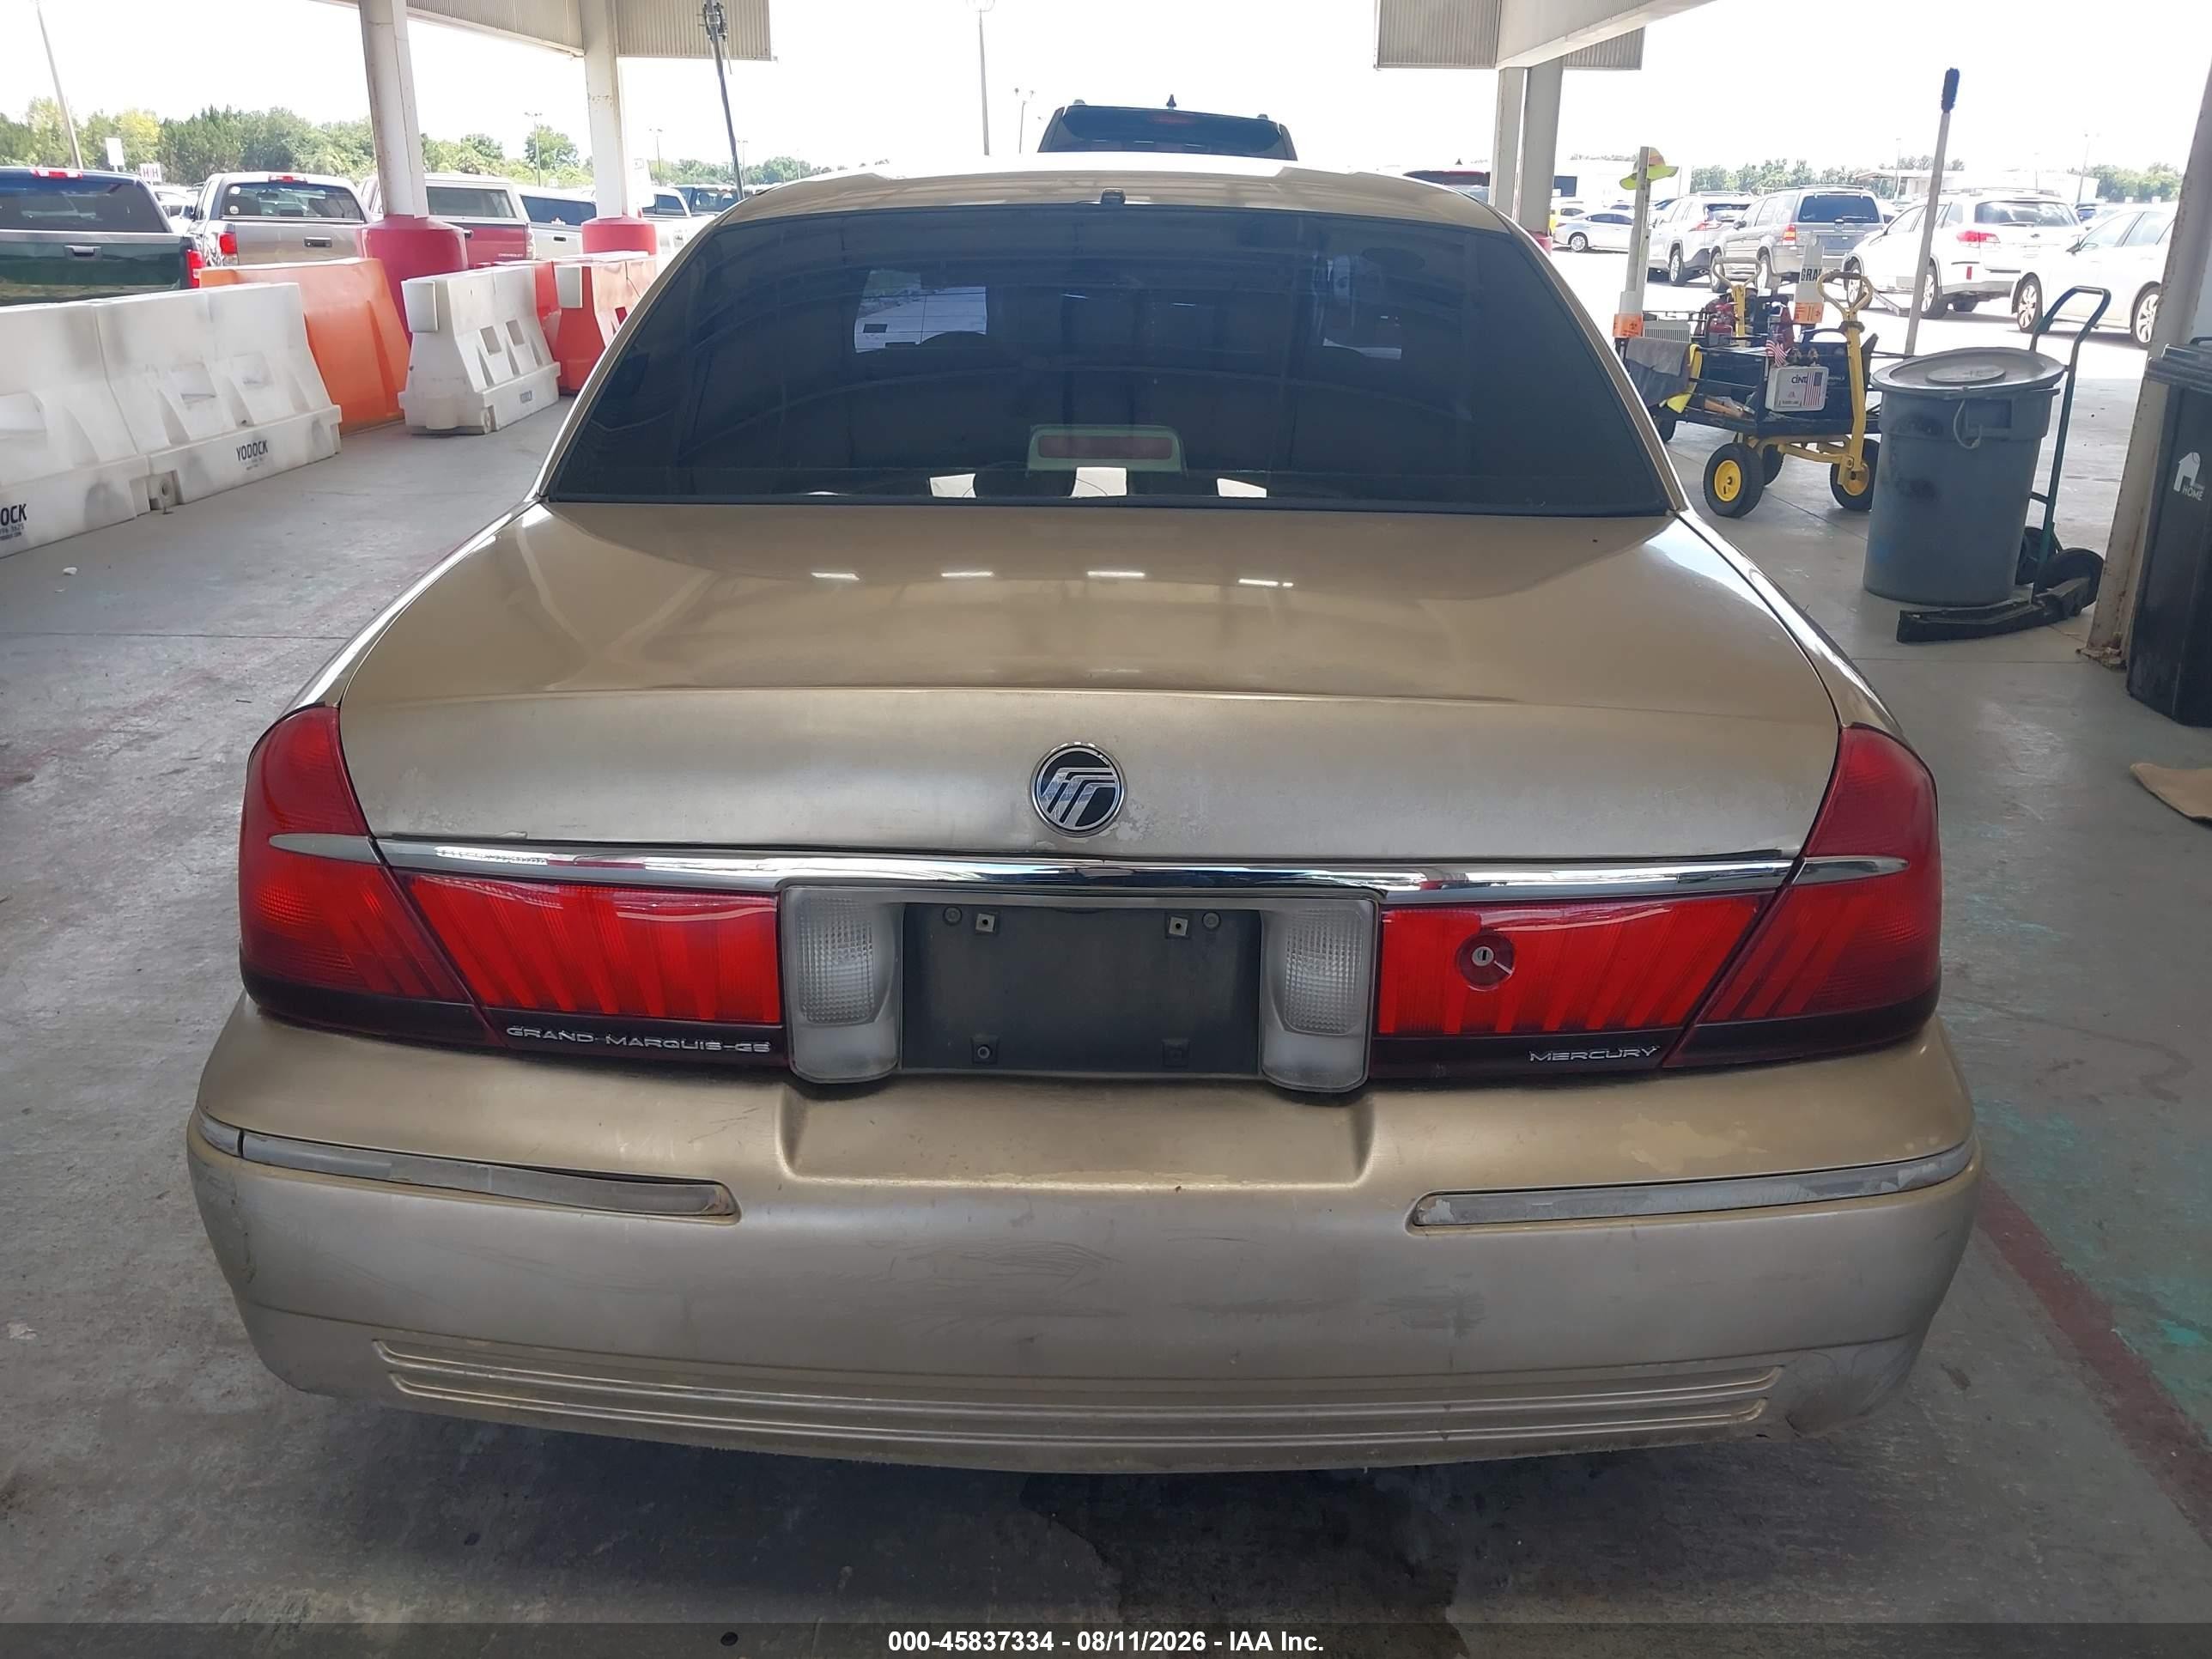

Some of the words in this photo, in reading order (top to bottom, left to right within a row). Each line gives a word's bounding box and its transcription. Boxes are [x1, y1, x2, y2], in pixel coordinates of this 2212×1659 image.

[235, 439, 269, 461] YODOCK
[2182, 484, 2204, 501] HOME
[506, 1025, 594, 1043] GRAND
[1529, 1045, 1660, 1062] MERCURY
